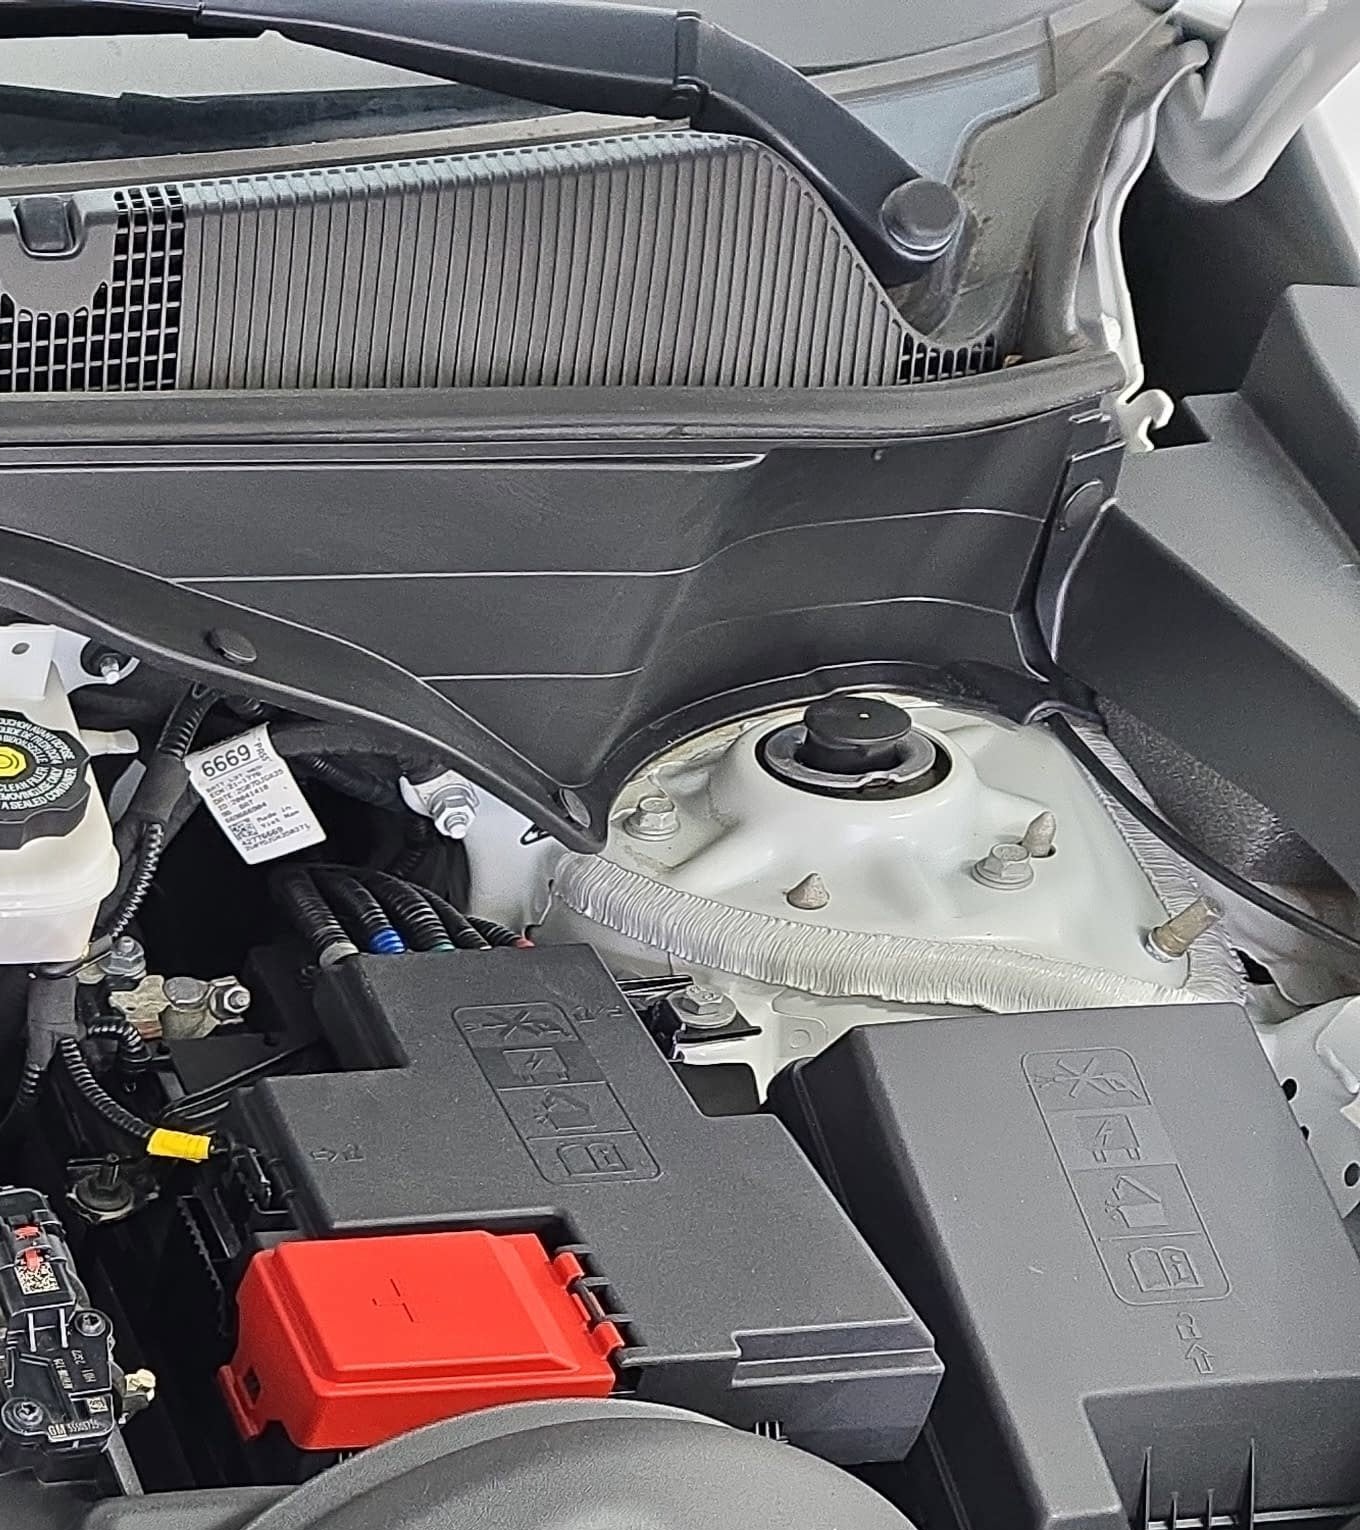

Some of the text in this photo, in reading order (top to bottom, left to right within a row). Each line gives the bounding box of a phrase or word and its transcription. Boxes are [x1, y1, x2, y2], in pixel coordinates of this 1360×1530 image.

[201, 744, 251, 777] 6669
[1, 801, 10, 810] A
[9, 796, 48, 810] SEALED
[44, 767, 77, 801] CONTAINER
[47, 1423, 67, 1437] GM
